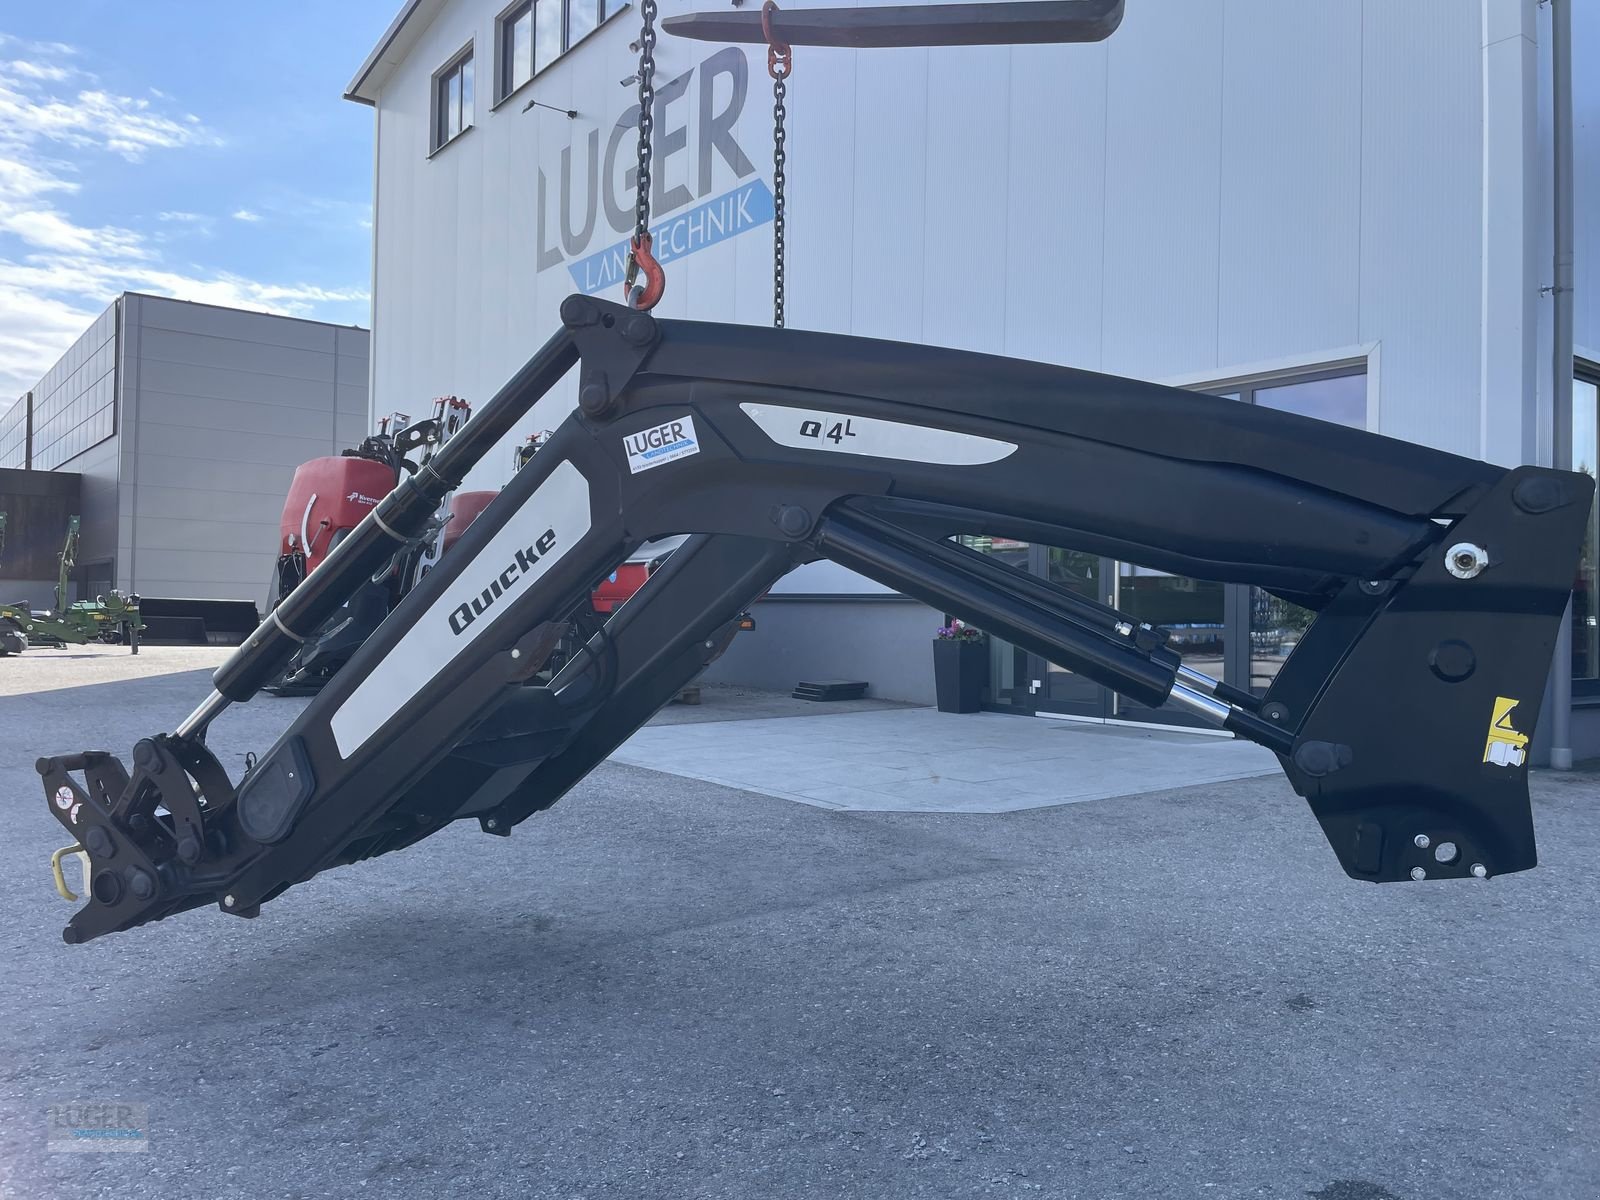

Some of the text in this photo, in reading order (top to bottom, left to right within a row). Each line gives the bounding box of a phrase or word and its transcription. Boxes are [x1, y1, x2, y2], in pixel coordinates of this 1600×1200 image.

[536, 47, 756, 273] LUGER
[586, 188, 753, 290] LANECHNIK
[626, 422, 687, 457] LUGER
[448, 528, 556, 635] Quicke
